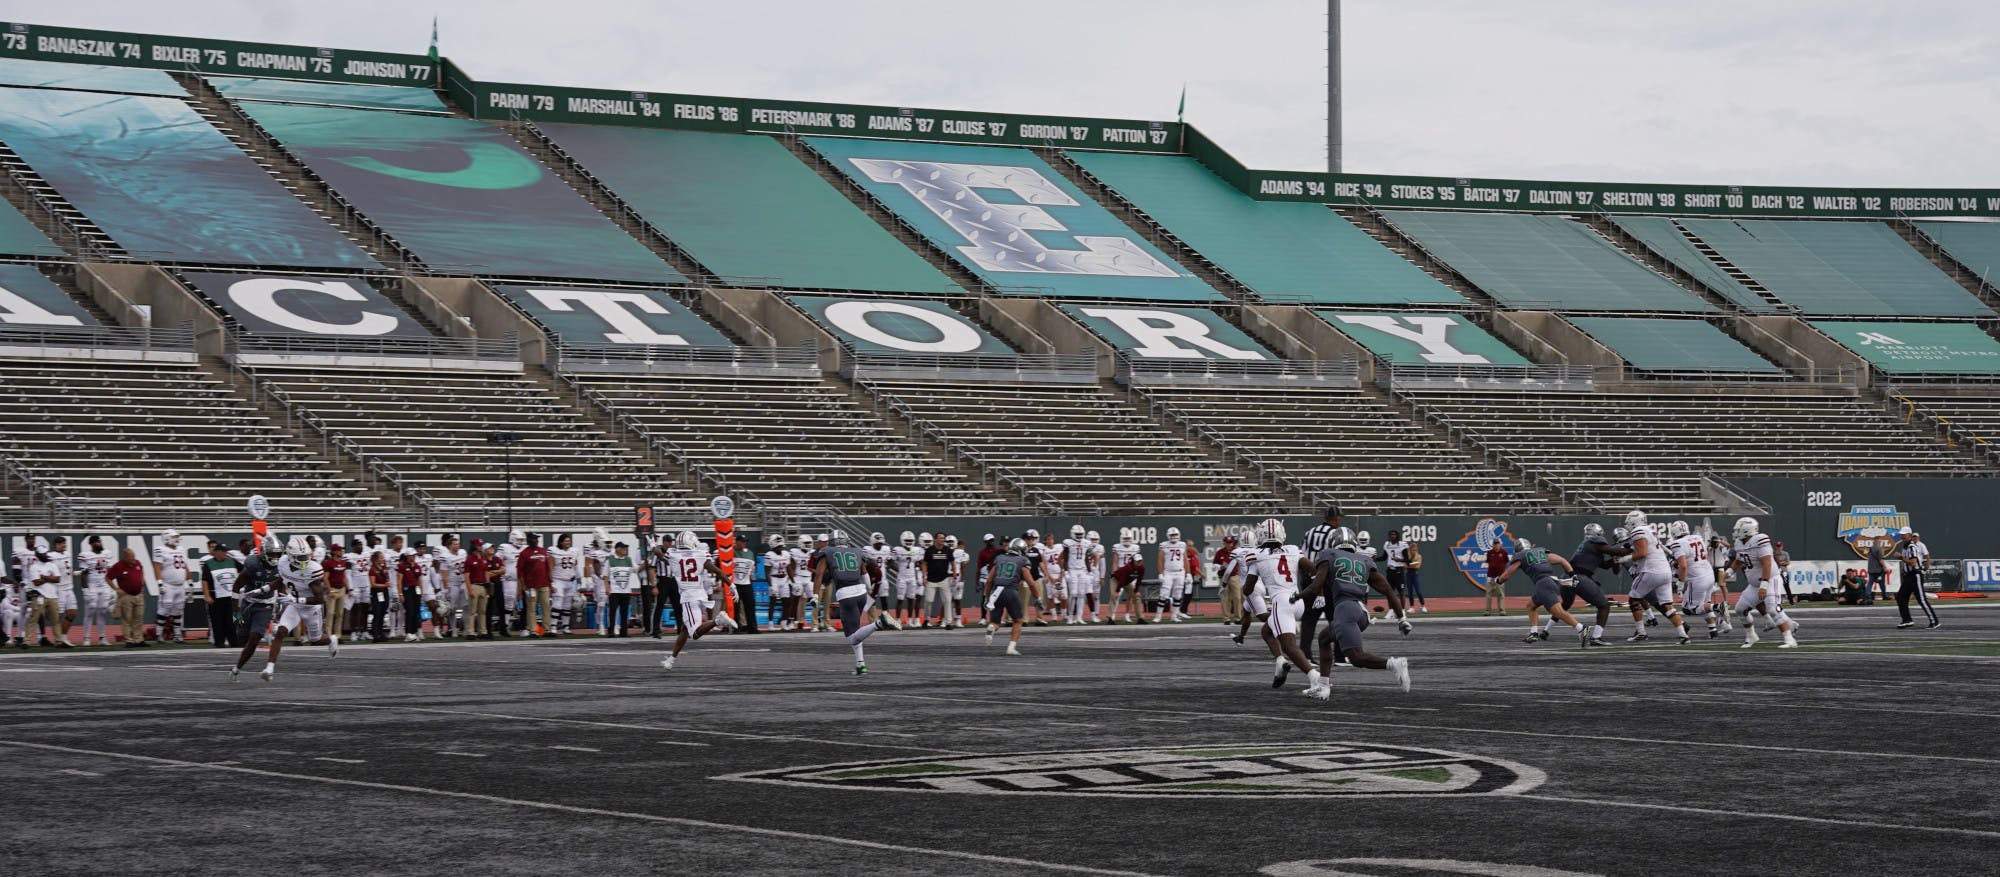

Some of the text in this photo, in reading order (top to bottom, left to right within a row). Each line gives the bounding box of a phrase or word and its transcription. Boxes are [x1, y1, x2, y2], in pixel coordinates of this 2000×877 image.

[2, 33, 27, 50] '73
[37, 36, 141, 59] BANASZAK '74
[152, 45, 227, 66] BIXLER '75
[237, 51, 334, 74] CHAPMAN '75
[343, 60, 431, 81] JOHNSON '77
[490, 92, 554, 111] PARM '79
[568, 97, 661, 117] MARSHALL '84
[673, 103, 739, 122] FIELDS '86
[751, 108, 856, 129] PETERSMARK '86
[868, 114, 935, 133] ADAMS '87
[942, 119, 1007, 137] CLOUSE '87
[1019, 123, 1089, 141] GORDON '87
[1102, 127, 1168, 145] PATTON '87
[1260, 179, 1326, 196] ADAMS '94
[1334, 182, 1382, 198] RICE '94
[1390, 184, 1456, 201] STOKES '95
[1462, 187, 1521, 203] BATCH '97
[1529, 189, 1594, 205] DALTON '97
[1602, 191, 1676, 207] SHELTON '98
[1684, 193, 1744, 208] SHORT '00
[1751, 195, 1805, 210] DACH '02
[1812, 196, 1881, 211] WALTER '02
[1889, 197, 1978, 211] ROBERSON '04
[1807, 492, 1842, 507] 2022
[637, 507, 652, 526] 2
[1402, 525, 1437, 542] 2019
[1525, 549, 1550, 566] 44
[1689, 541, 1707, 562] 72
[679, 558, 699, 582] 12
[834, 552, 858, 571] 16
[998, 561, 1018, 580] 19
[1277, 554, 1293, 583] 4
[1333, 557, 1368, 586] 29
[1967, 561, 2000, 582] DTE
